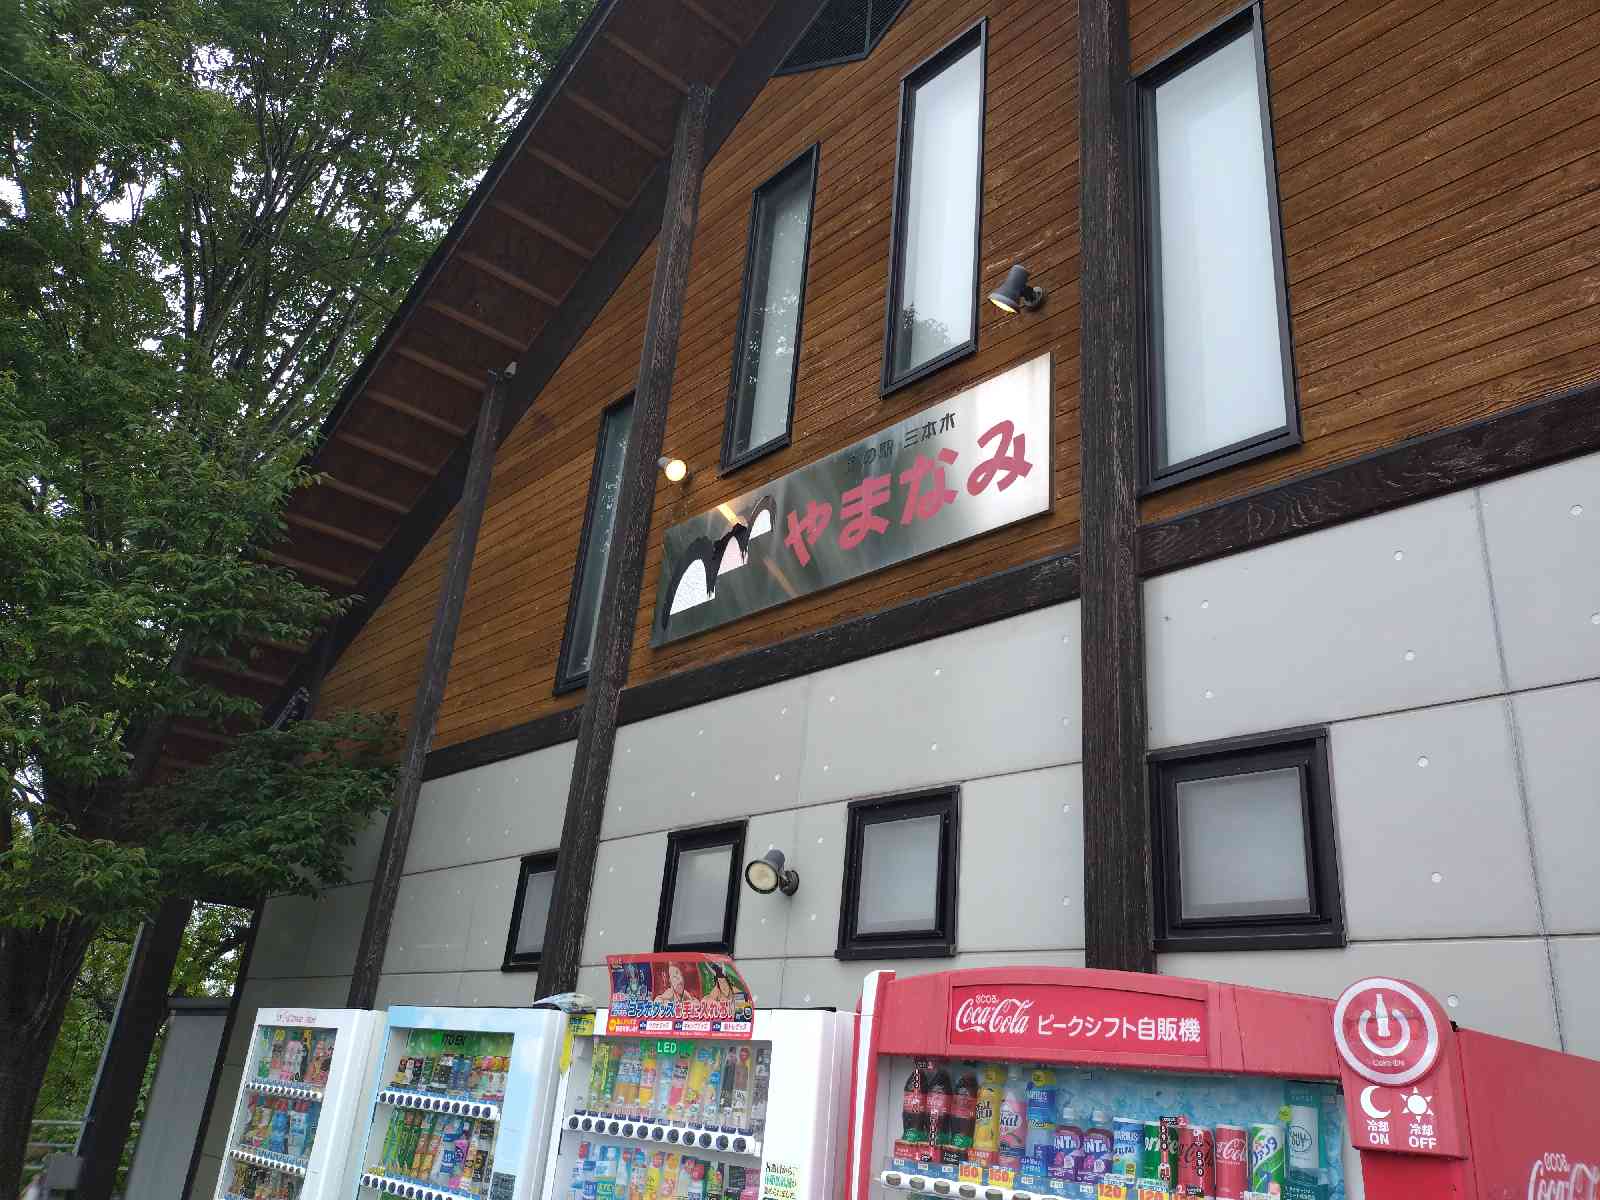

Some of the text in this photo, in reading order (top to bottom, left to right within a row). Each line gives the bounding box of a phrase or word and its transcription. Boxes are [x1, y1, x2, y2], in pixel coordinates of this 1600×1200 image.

[904, 412, 956, 448] 三本木
[784, 420, 1033, 567] やまなみ
[955, 998, 1034, 1034] Coca-Cola
[1038, 1014, 1200, 1042] ピークシフト自販機
[657, 1042, 677, 1053] LED
[1366, 1119, 1389, 1132] 冷却
[1410, 1123, 1434, 1135] 冷却
[1369, 1133, 1390, 1145] ON
[1408, 1135, 1437, 1149] OFF
